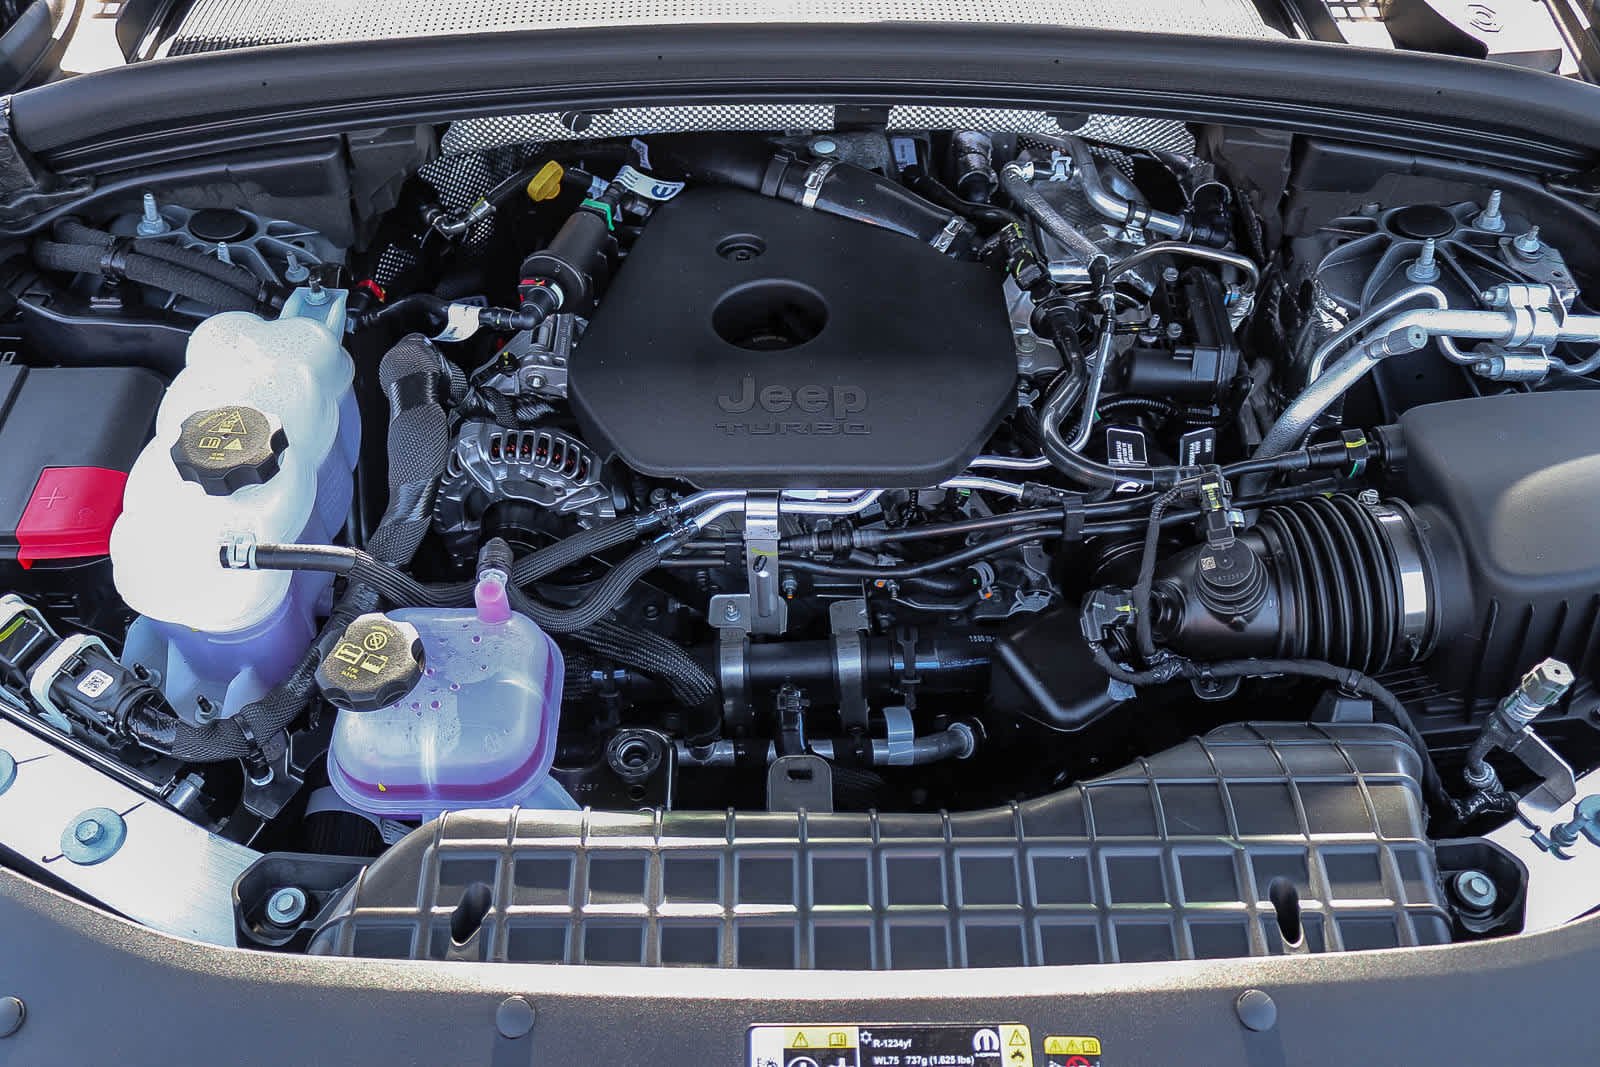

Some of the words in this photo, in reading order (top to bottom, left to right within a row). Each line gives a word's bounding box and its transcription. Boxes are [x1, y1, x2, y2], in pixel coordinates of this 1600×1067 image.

[717, 374, 869, 421] Jeep
[714, 422, 872, 436] TURBO
[873, 1038, 912, 1050] R-1234yf
[874, 1055, 900, 1065] WL75
[906, 1055, 928, 1067] 737g
[957, 1055, 975, 1066] lbs)
